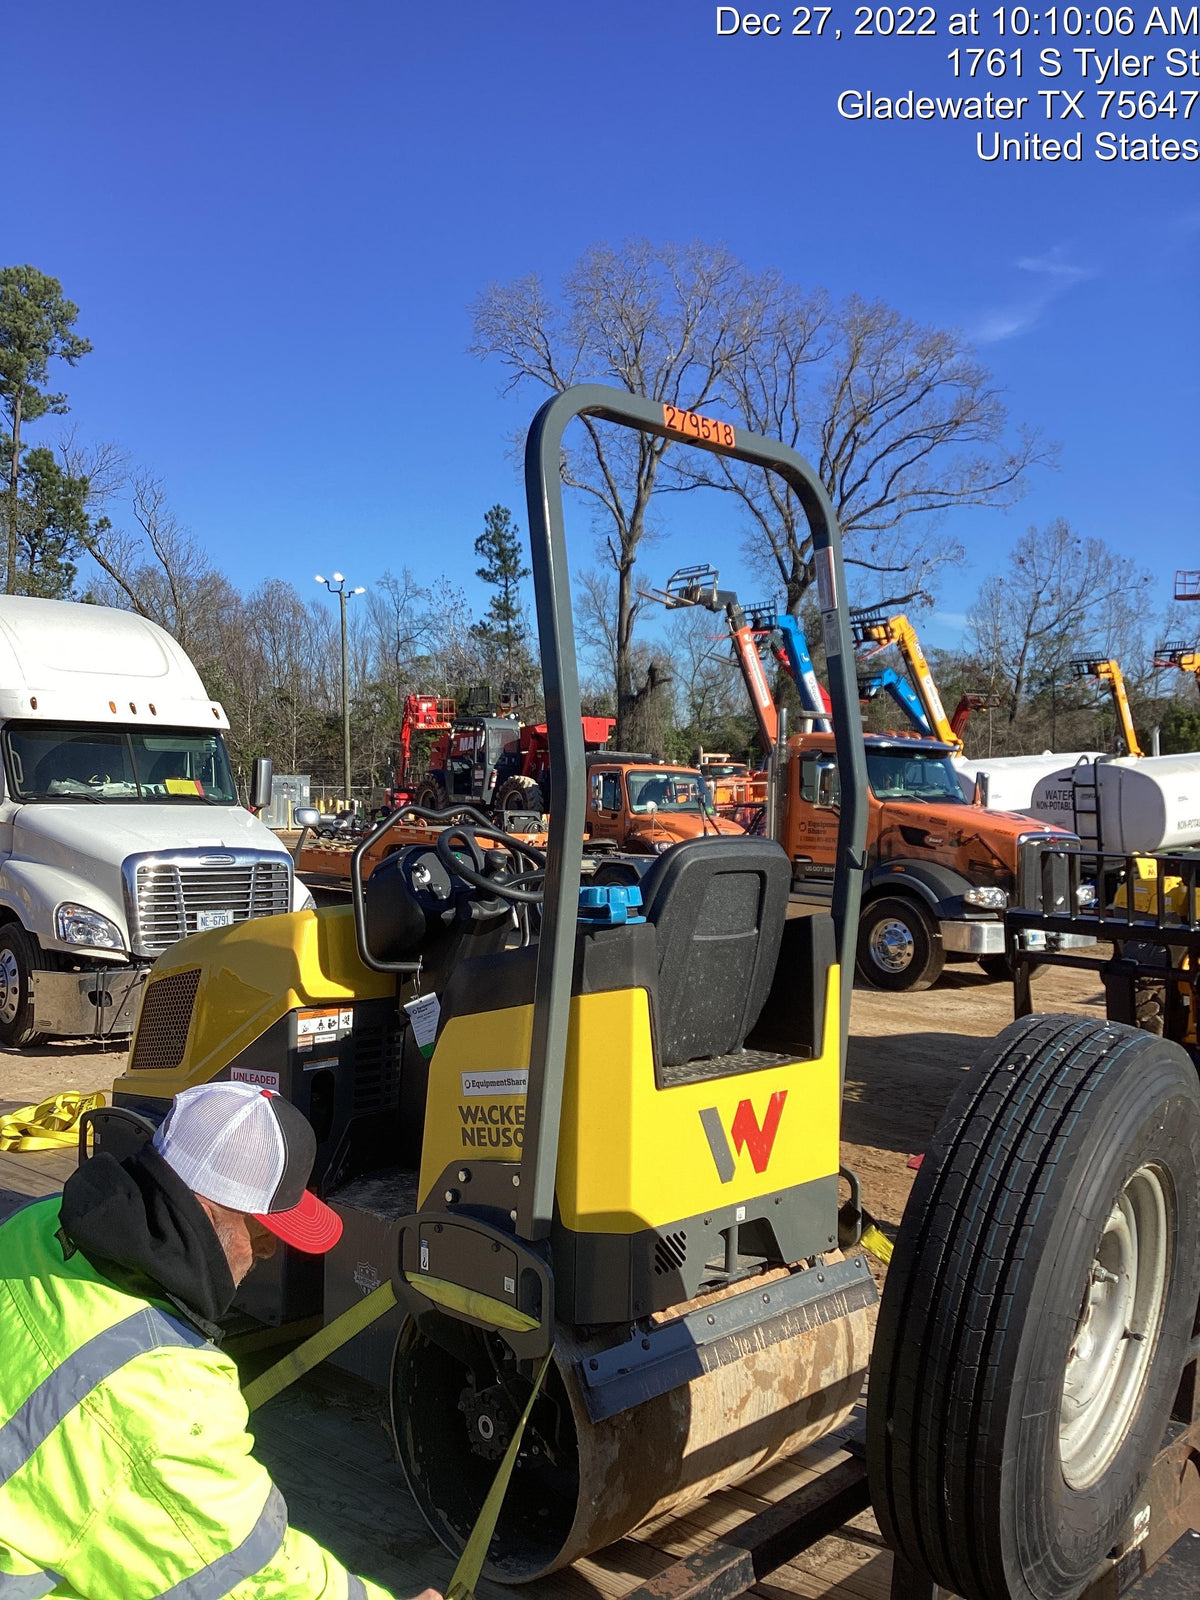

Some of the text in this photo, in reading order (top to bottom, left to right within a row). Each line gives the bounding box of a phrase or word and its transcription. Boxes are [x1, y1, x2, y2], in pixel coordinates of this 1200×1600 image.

[665, 406, 734, 446] 279518
[1045, 790, 1075, 801] WATER
[1036, 801, 1074, 811] NON-POTABL
[232, 1071, 277, 1086] UNLEADED
[471, 1078, 527, 1089] EquipmentShare
[458, 1105, 526, 1126] WACKE
[461, 1127, 526, 1147] NEUSO
